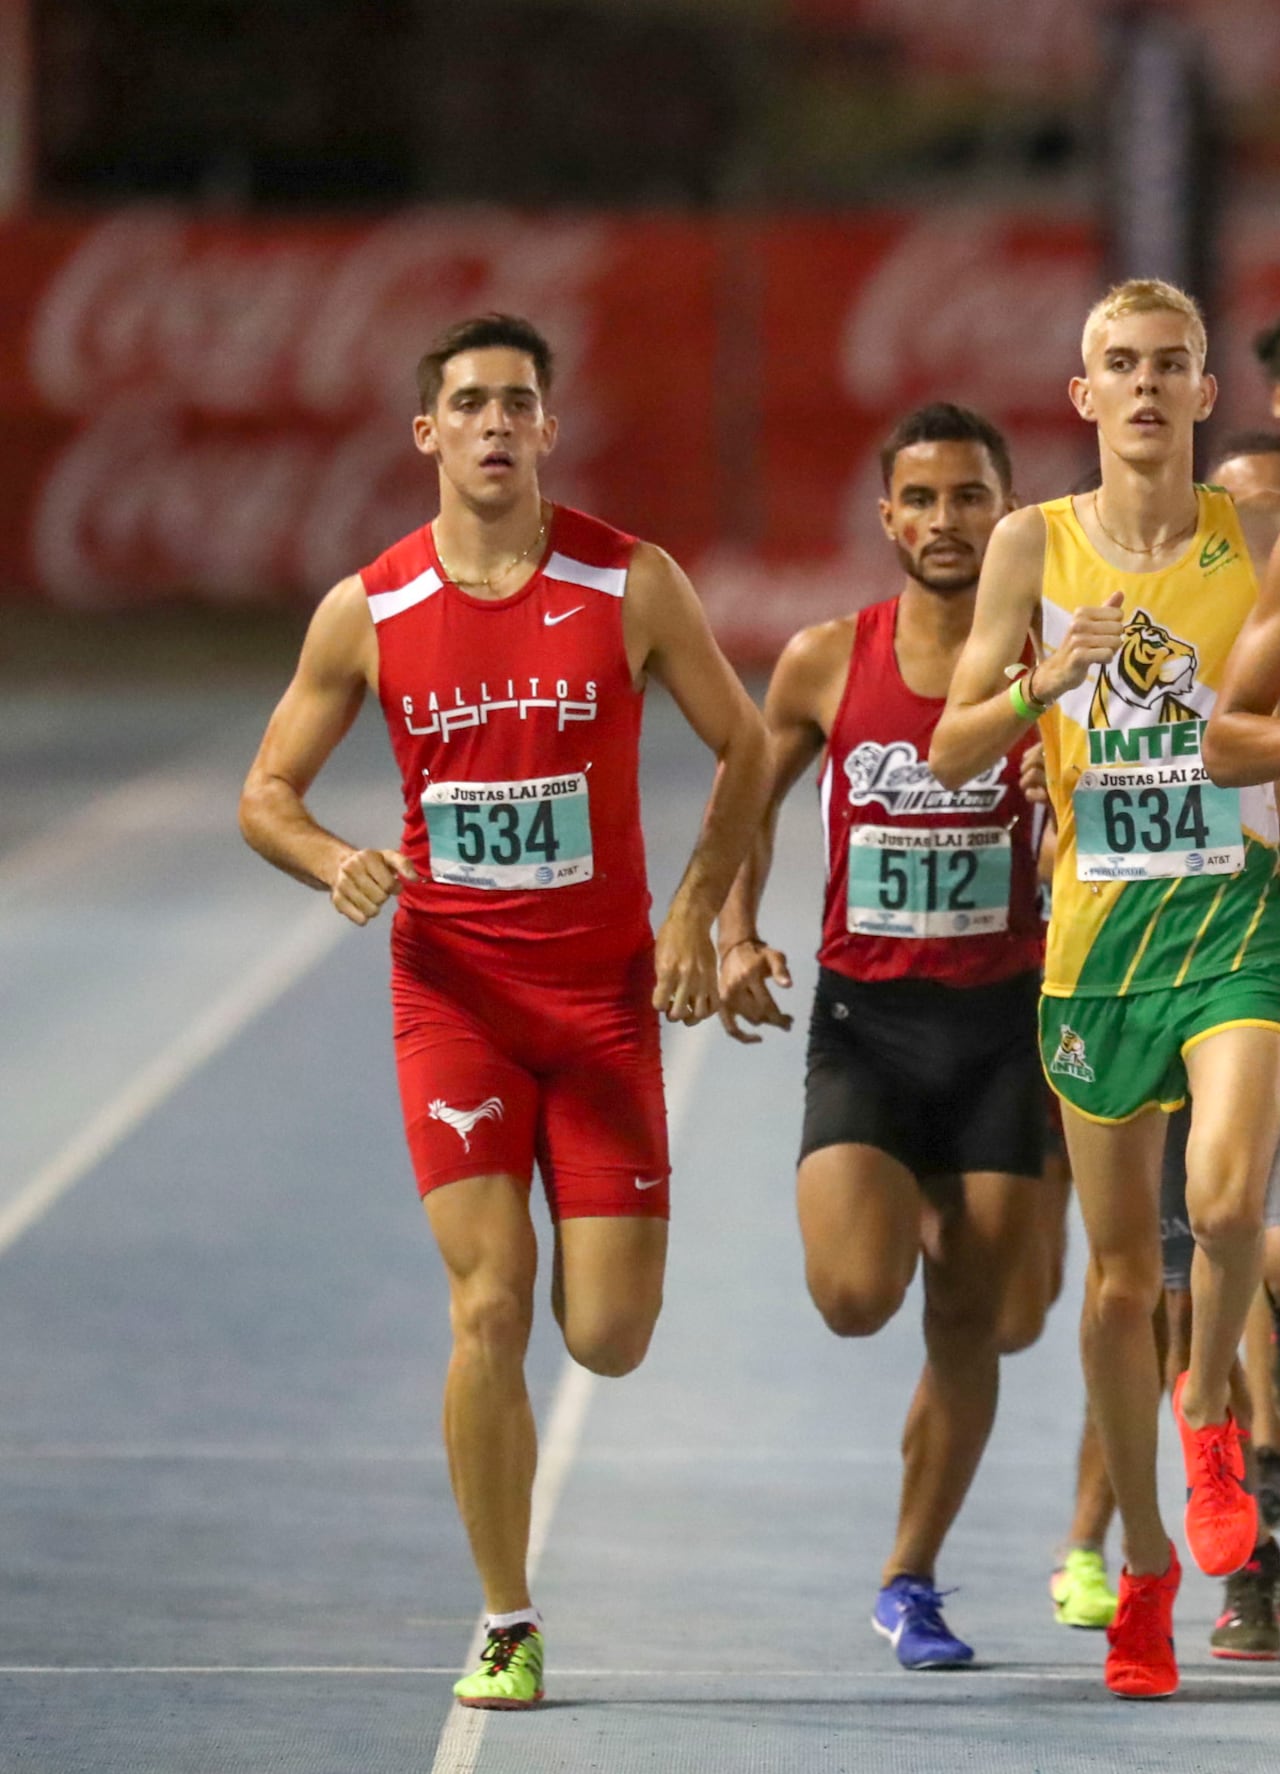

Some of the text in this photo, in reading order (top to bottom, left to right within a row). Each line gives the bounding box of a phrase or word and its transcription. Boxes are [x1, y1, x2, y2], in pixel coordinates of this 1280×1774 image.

[402, 678, 597, 714] GALLITOS
[451, 779, 578, 801] JUSTAS LAI 2019
[1100, 768, 1209, 787] JUSTAS LAI 20
[455, 800, 559, 865] 534
[1103, 785, 1209, 853] 634
[878, 833, 930, 847] JUSTAS
[935, 834, 962, 847] LAI
[1207, 855, 1230, 865] AT&T
[879, 849, 978, 911] 512
